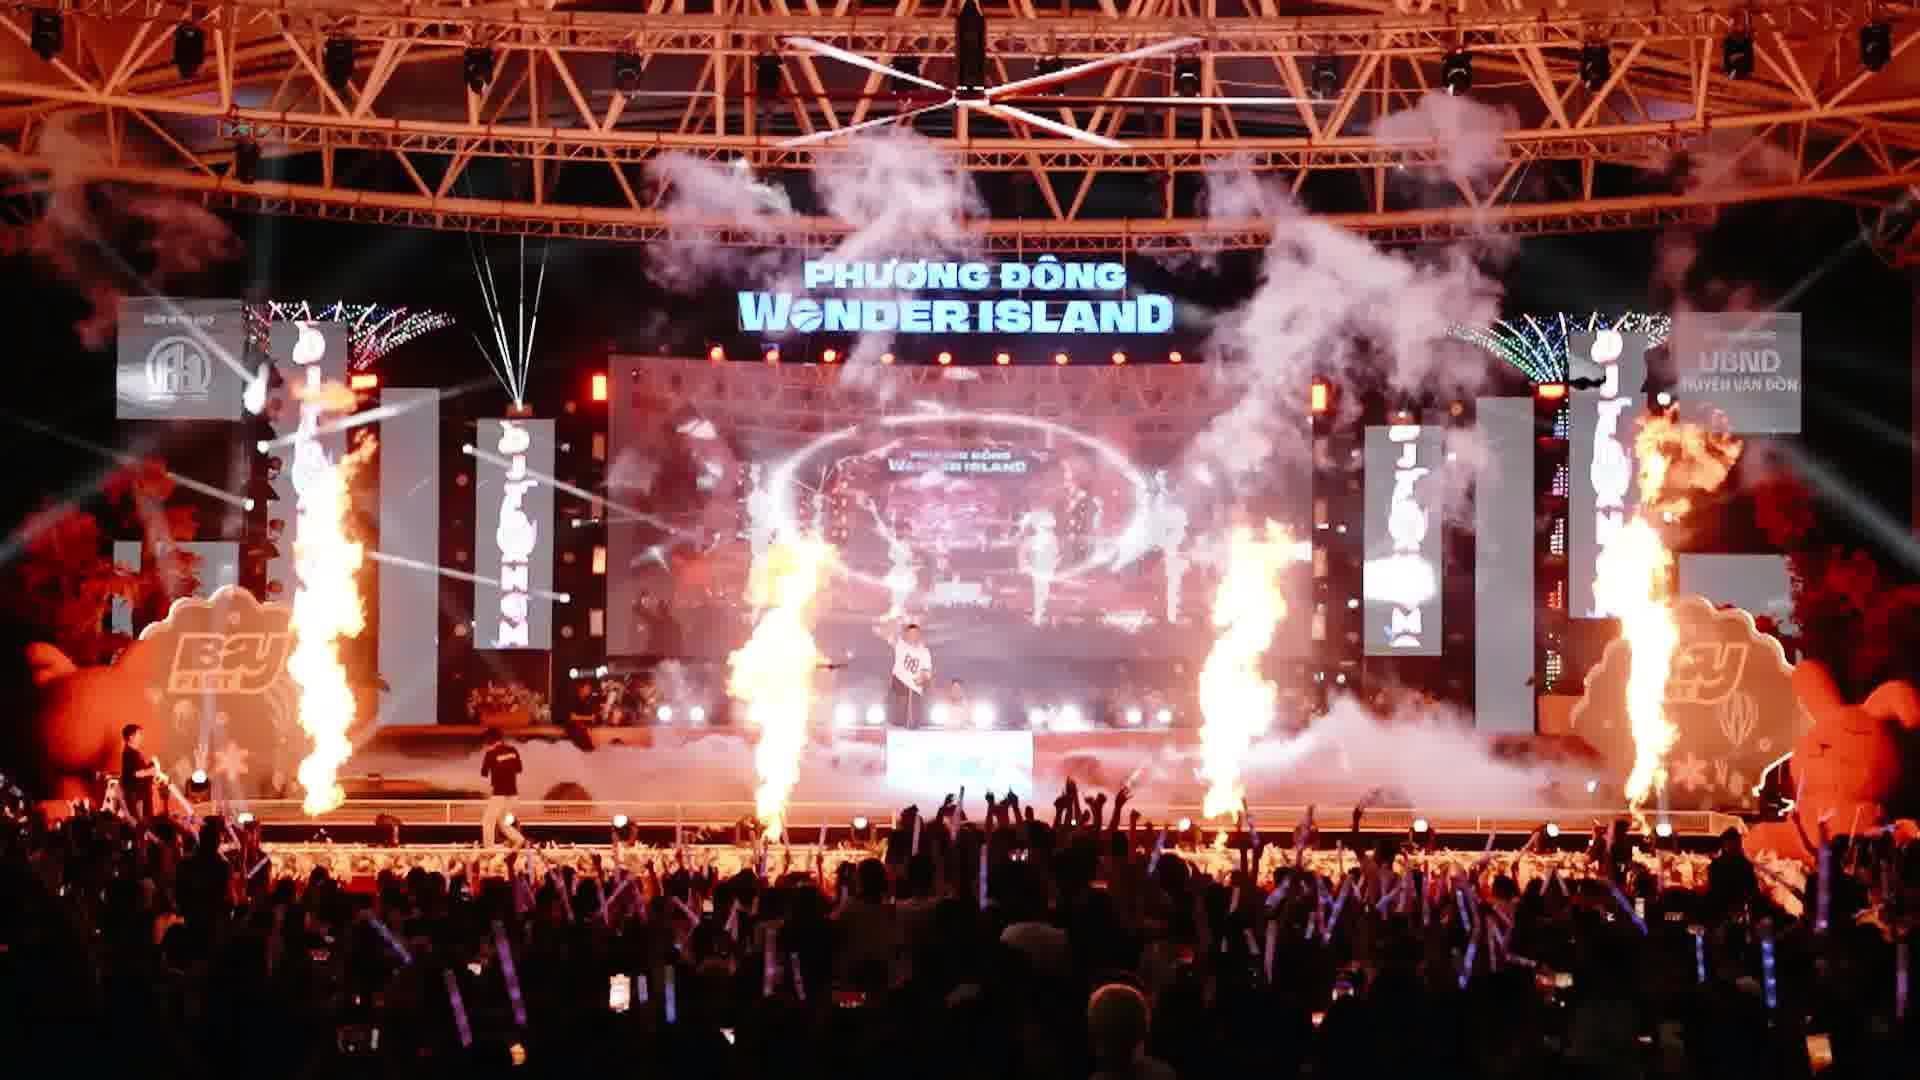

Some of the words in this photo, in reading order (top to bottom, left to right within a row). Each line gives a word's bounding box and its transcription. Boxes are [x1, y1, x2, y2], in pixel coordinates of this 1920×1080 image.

[804, 257, 990, 291] PHƯƠNG
[1000, 255, 1127, 290] ĐÔNG
[737, 292, 968, 334] WONDER
[980, 294, 1176, 334] ISLAND
